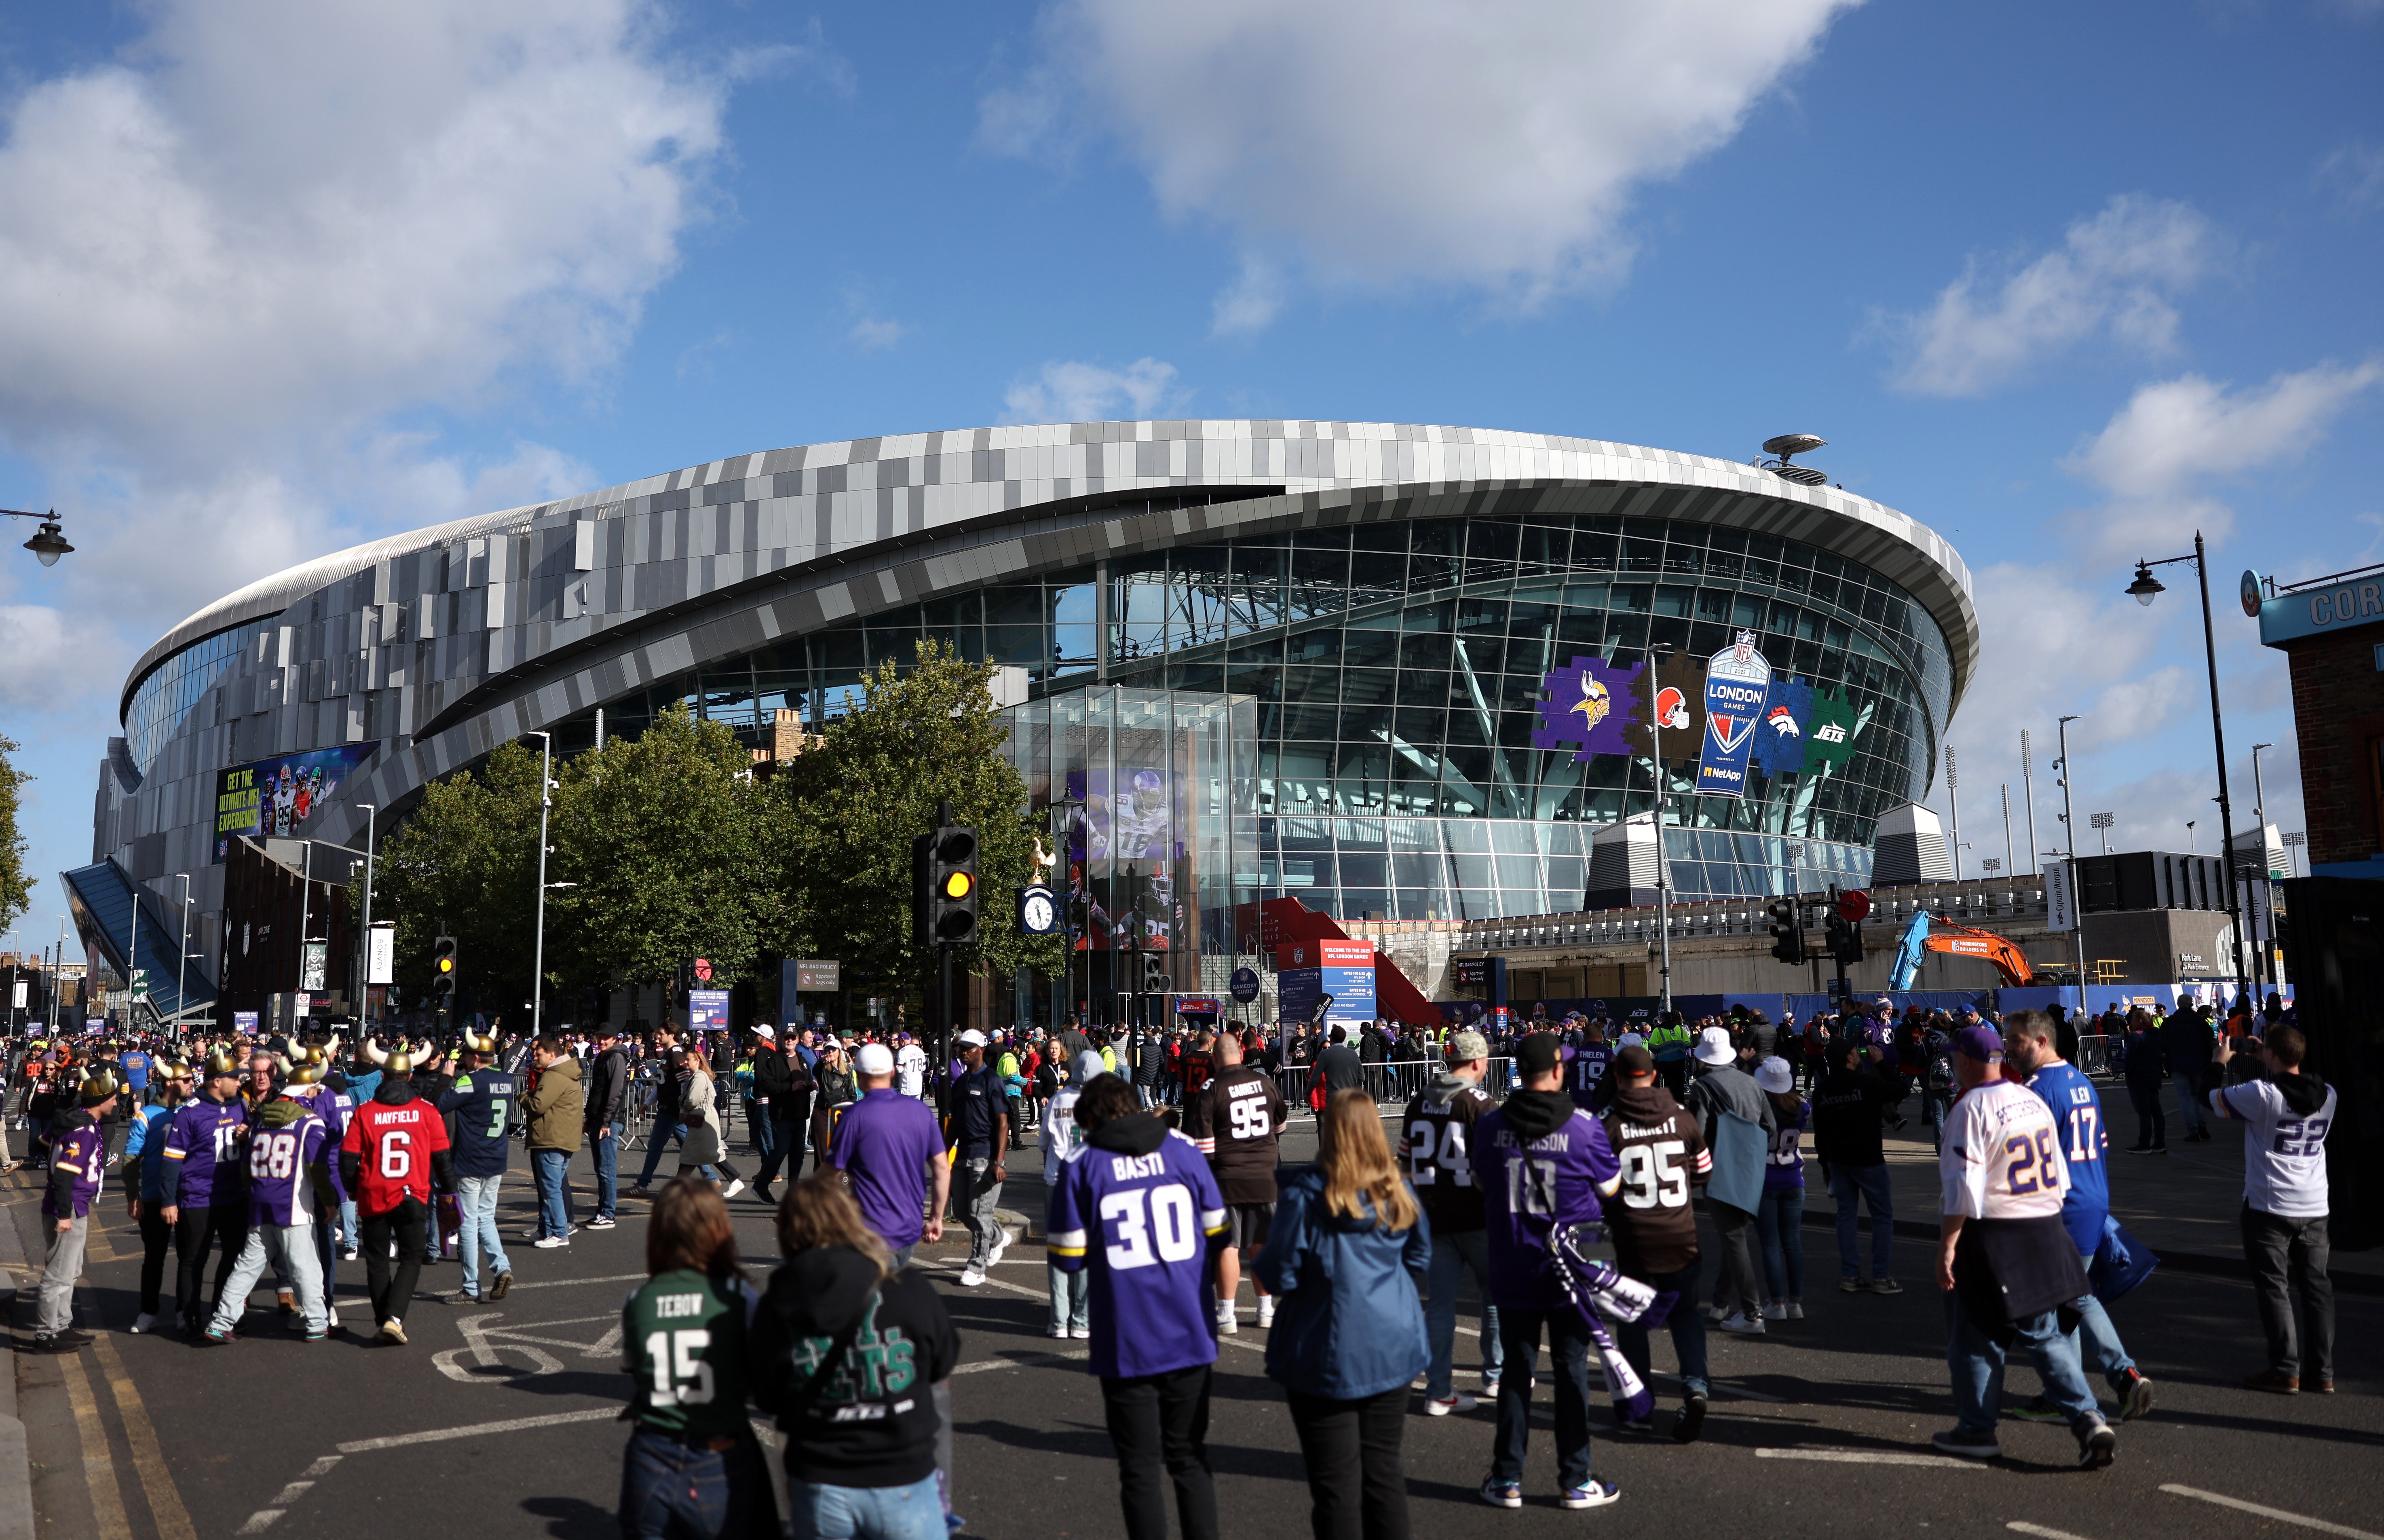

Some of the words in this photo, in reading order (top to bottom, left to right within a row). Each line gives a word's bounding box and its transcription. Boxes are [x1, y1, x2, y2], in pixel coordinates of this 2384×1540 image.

[1736, 644, 1750, 661] NFL
[1709, 684, 1763, 704] LONDON
[1723, 702, 1745, 710] GAMES
[1813, 720, 1846, 743] JETS
[227, 771, 240, 791] GET
[241, 769, 253, 788] THE
[1712, 768, 1741, 782] NetApp
[219, 790, 246, 812] ULTIMATE
[248, 788, 260, 807] NFL
[219, 809, 258, 832] EXPERIENCE
[278, 806, 289, 826] 95
[1121, 832, 1153, 852] 18
[2053, 868, 2062, 890] Morgan
[2055, 890, 2064, 911] Captain
[2181, 953, 2191, 961] Park
[2191, 953, 2202, 962] Lane
[1313, 1005, 1326, 1022] CRUNCH
[1324, 997, 1332, 1006] TIME
[1629, 1008, 1649, 1017] JETS
[518, 1045, 528, 1059] TIME
[1579, 1051, 1605, 1059] THIELEN
[26, 1063, 42, 1076] 80
[910, 1058, 922, 1073] 78
[489, 1083, 512, 1094] WILSON
[1186, 1067, 1207, 1092] 13
[1228, 1080, 1263, 1098] GARRETT
[1820, 1089, 1862, 1107] Arsenal
[374, 1110, 420, 1125] MAYFIELD
[486, 1099, 507, 1138] 3
[1229, 1096, 1270, 1139] 95
[2069, 1106, 2098, 1162] 17
[2273, 1119, 2329, 1157] 22
[250, 1132, 296, 1179] 28
[381, 1130, 411, 1178] 6
[1411, 1120, 1472, 1187] 24
[2004, 1126, 2058, 1196] 28
[1112, 1151, 1165, 1181] BASTI
[1619, 1141, 1688, 1208] 95
[1100, 1183, 1196, 1270] 30
[656, 1293, 704, 1318] TEBOW
[646, 1328, 716, 1407] 15
